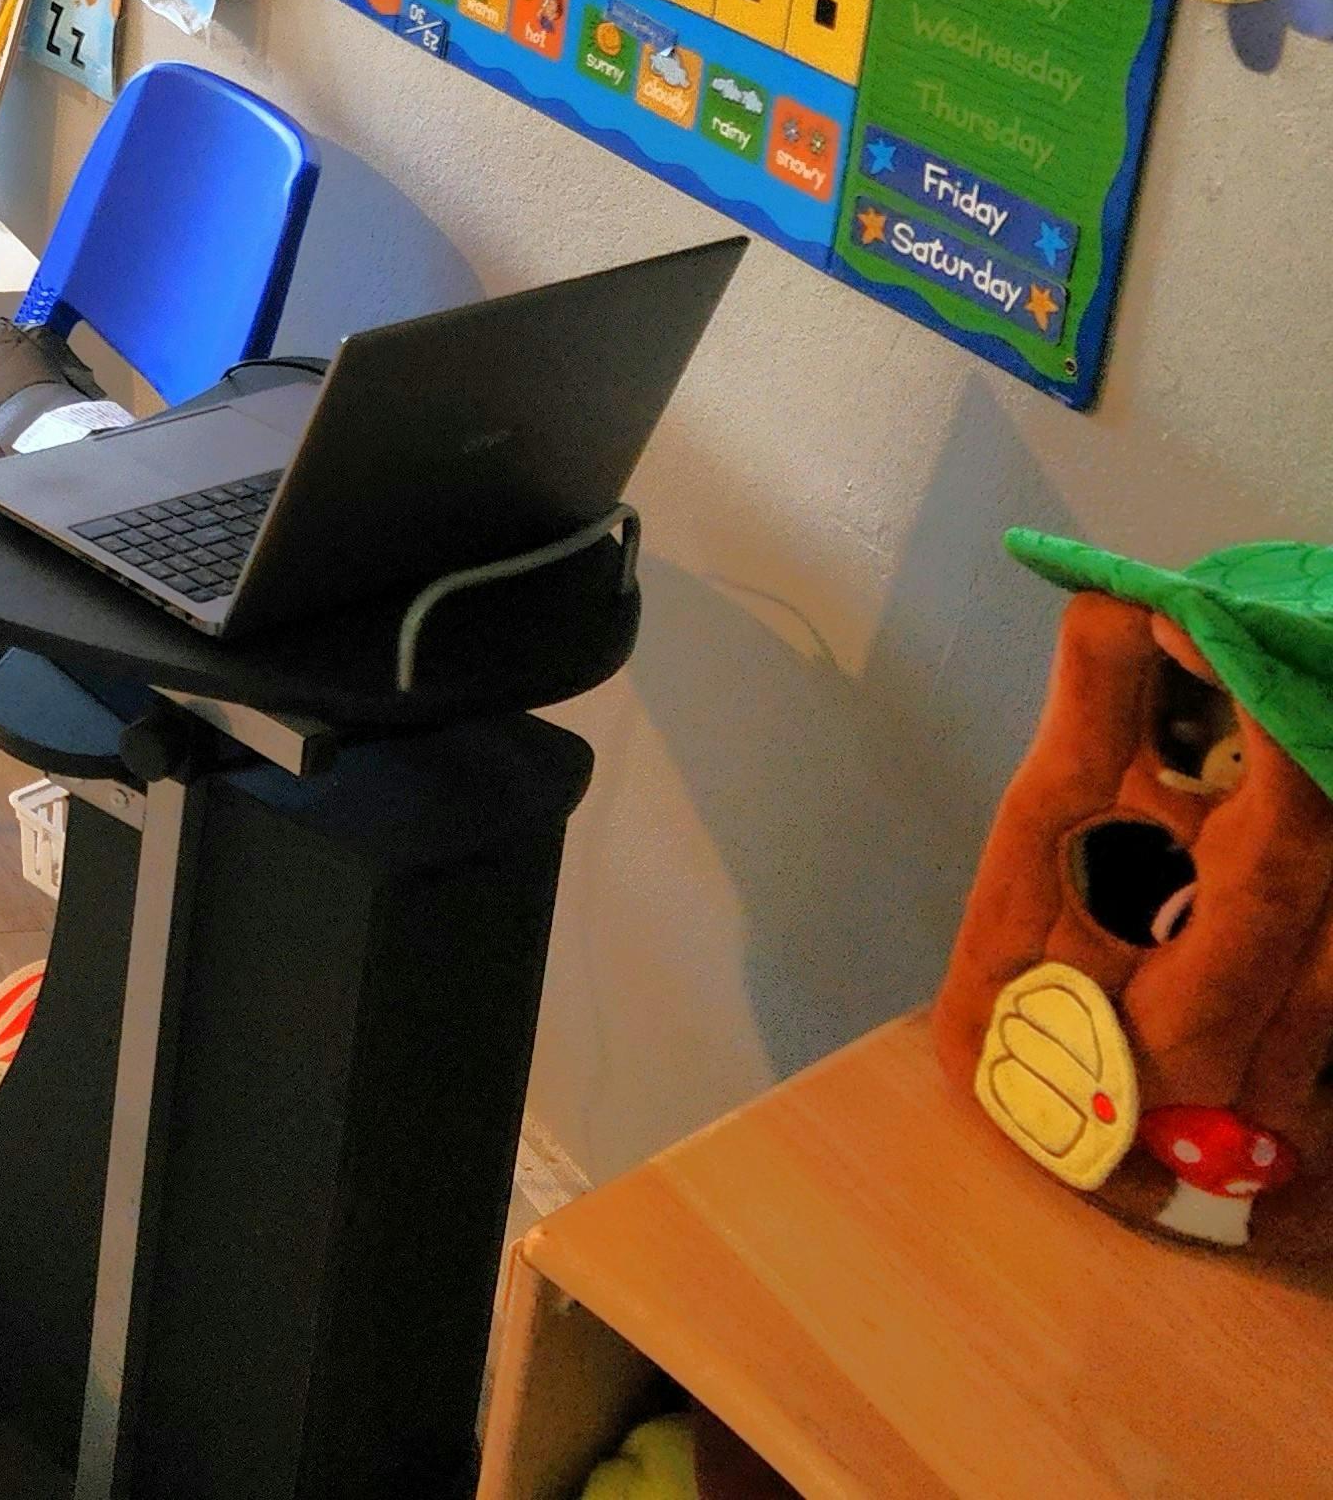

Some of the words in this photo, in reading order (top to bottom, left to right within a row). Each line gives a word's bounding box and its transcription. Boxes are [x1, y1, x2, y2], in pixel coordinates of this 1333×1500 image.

[46, 1, 87, 70] Zz
[524, 23, 546, 49] hot
[910, 4, 1083, 103] Wednesday
[586, 53, 626, 86] sunny
[641, 74, 689, 117] cloudy
[711, 115, 751, 151] rainy
[915, 81, 1056, 170] Thursday
[775, 147, 825, 190] snowy
[924, 162, 1008, 236] Friday
[891, 222, 1023, 312] Saturday
